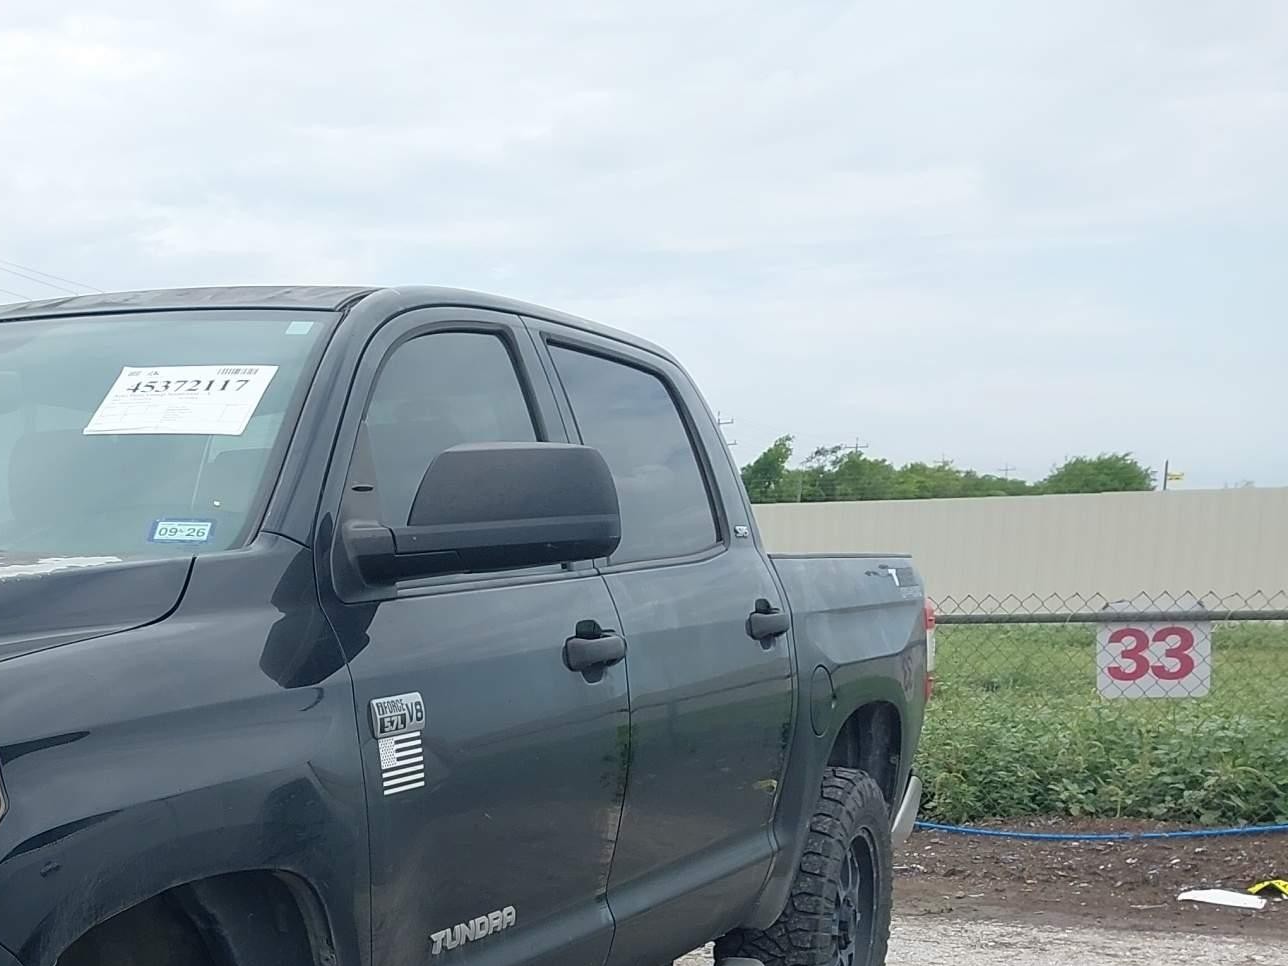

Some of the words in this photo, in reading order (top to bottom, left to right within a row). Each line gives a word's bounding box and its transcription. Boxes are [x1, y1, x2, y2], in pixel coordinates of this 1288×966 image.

[126, 379, 250, 393] 45372117
[158, 527, 178, 537] 09
[185, 527, 206, 537] 26
[1107, 627, 1194, 681] 33
[405, 701, 423, 722] V8
[430, 905, 516, 955] TUNDRA
